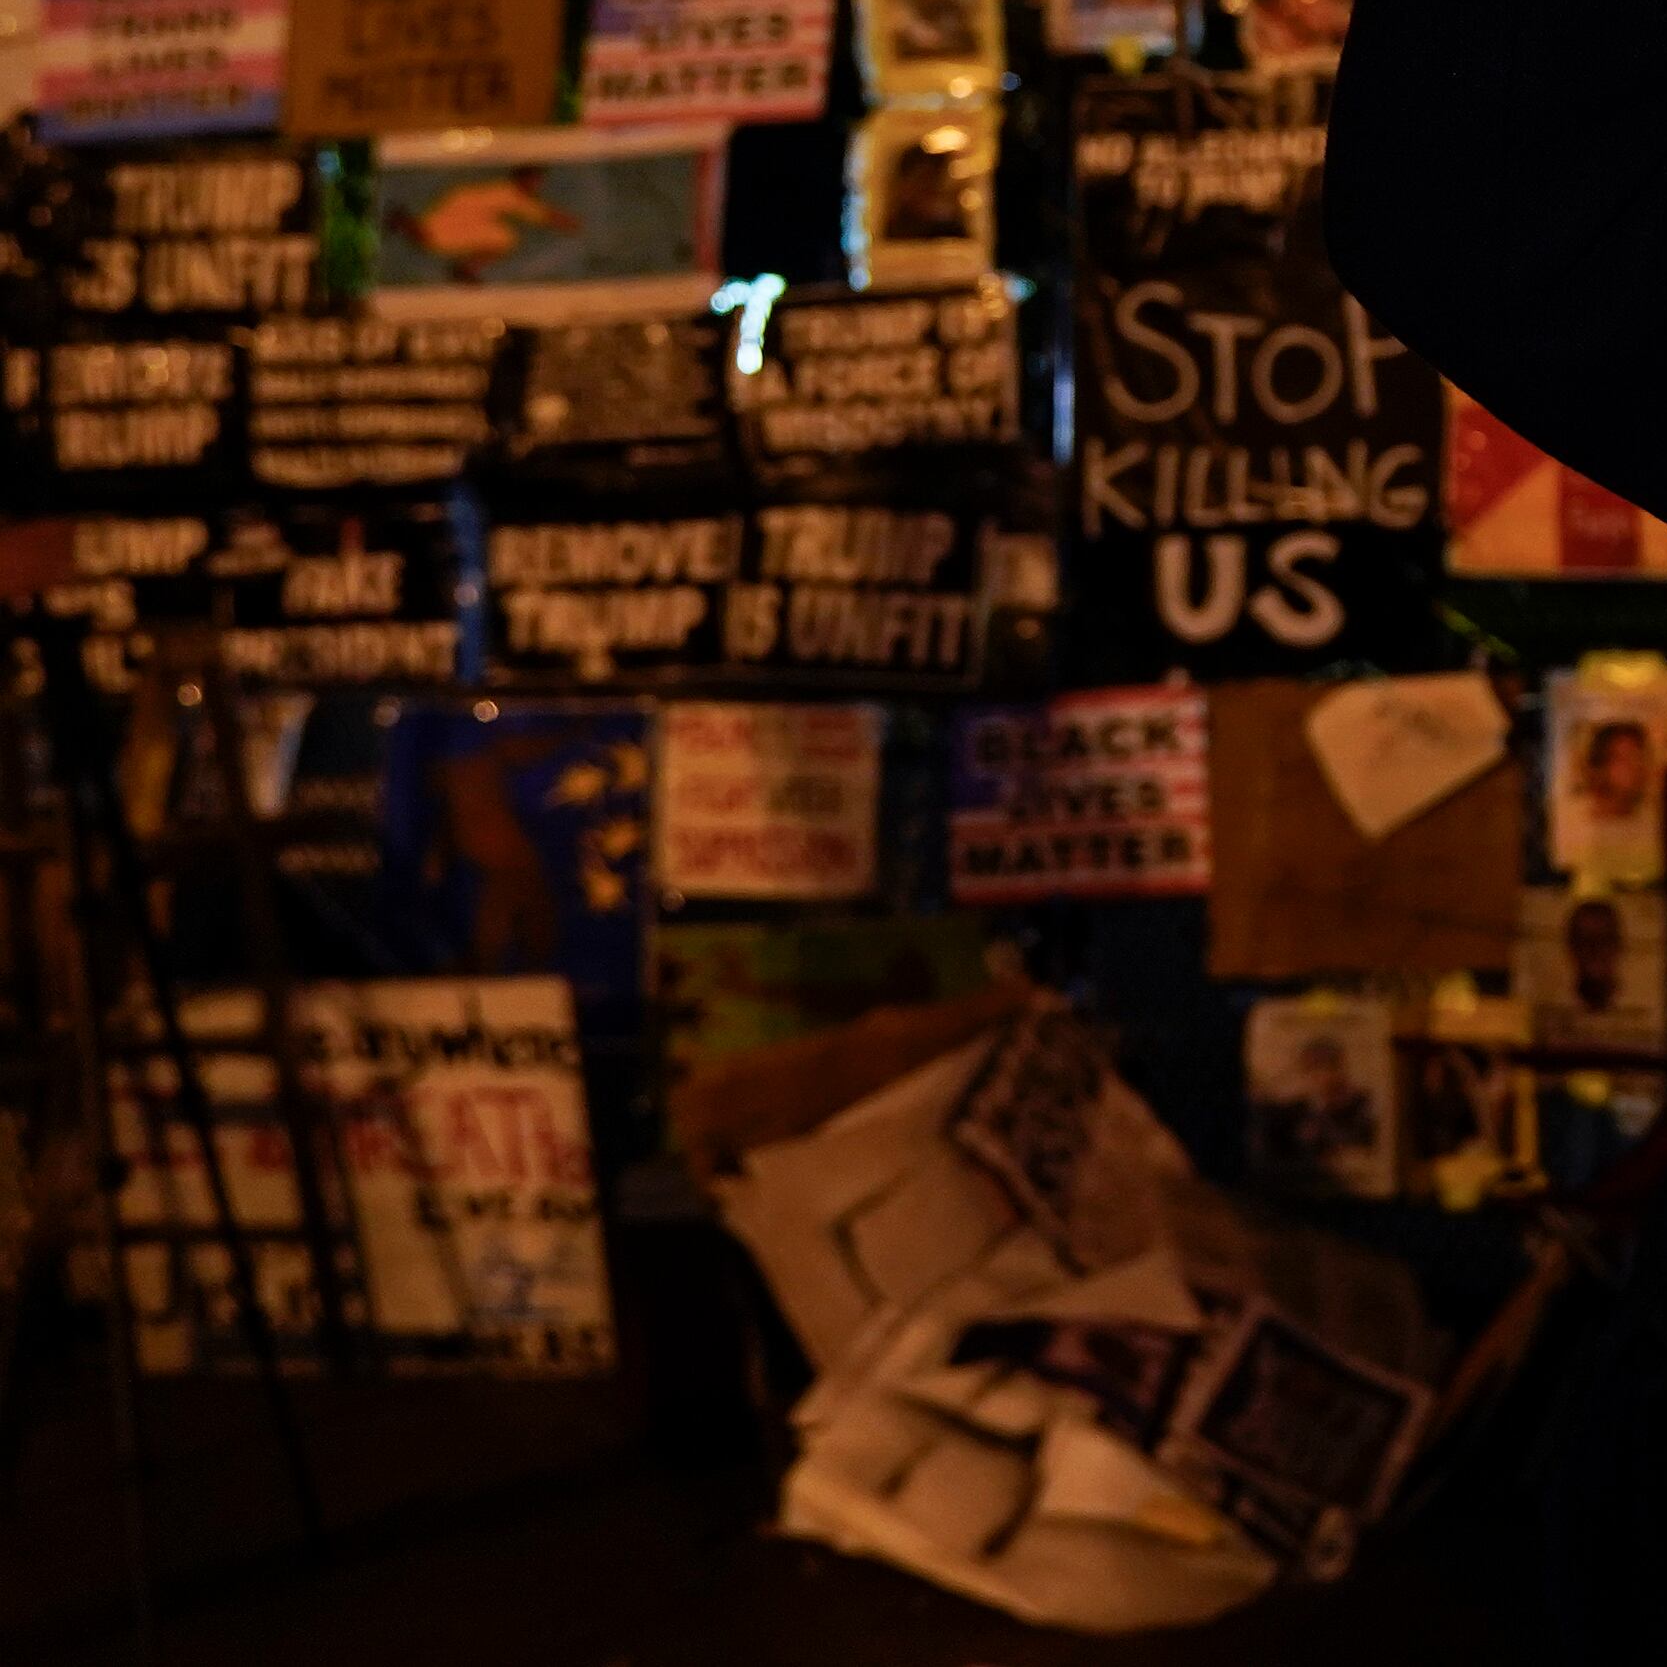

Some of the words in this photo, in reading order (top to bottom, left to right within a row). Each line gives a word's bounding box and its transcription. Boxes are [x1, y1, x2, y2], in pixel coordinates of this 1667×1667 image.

[641, 10, 791, 52] LIVES
[599, 61, 808, 99] MATTER
[1082, 437, 1432, 542] KILLING
[489, 519, 746, 587] REMOVE
[757, 504, 960, 587] TRUMP
[1153, 529, 1347, 650] US
[720, 584, 784, 661] IS
[787, 588, 972, 668] UNFIT
[975, 719, 1181, 767] BLACK
[1008, 780, 1165, 826] LIVES
[966, 833, 1190, 876] MATTER
